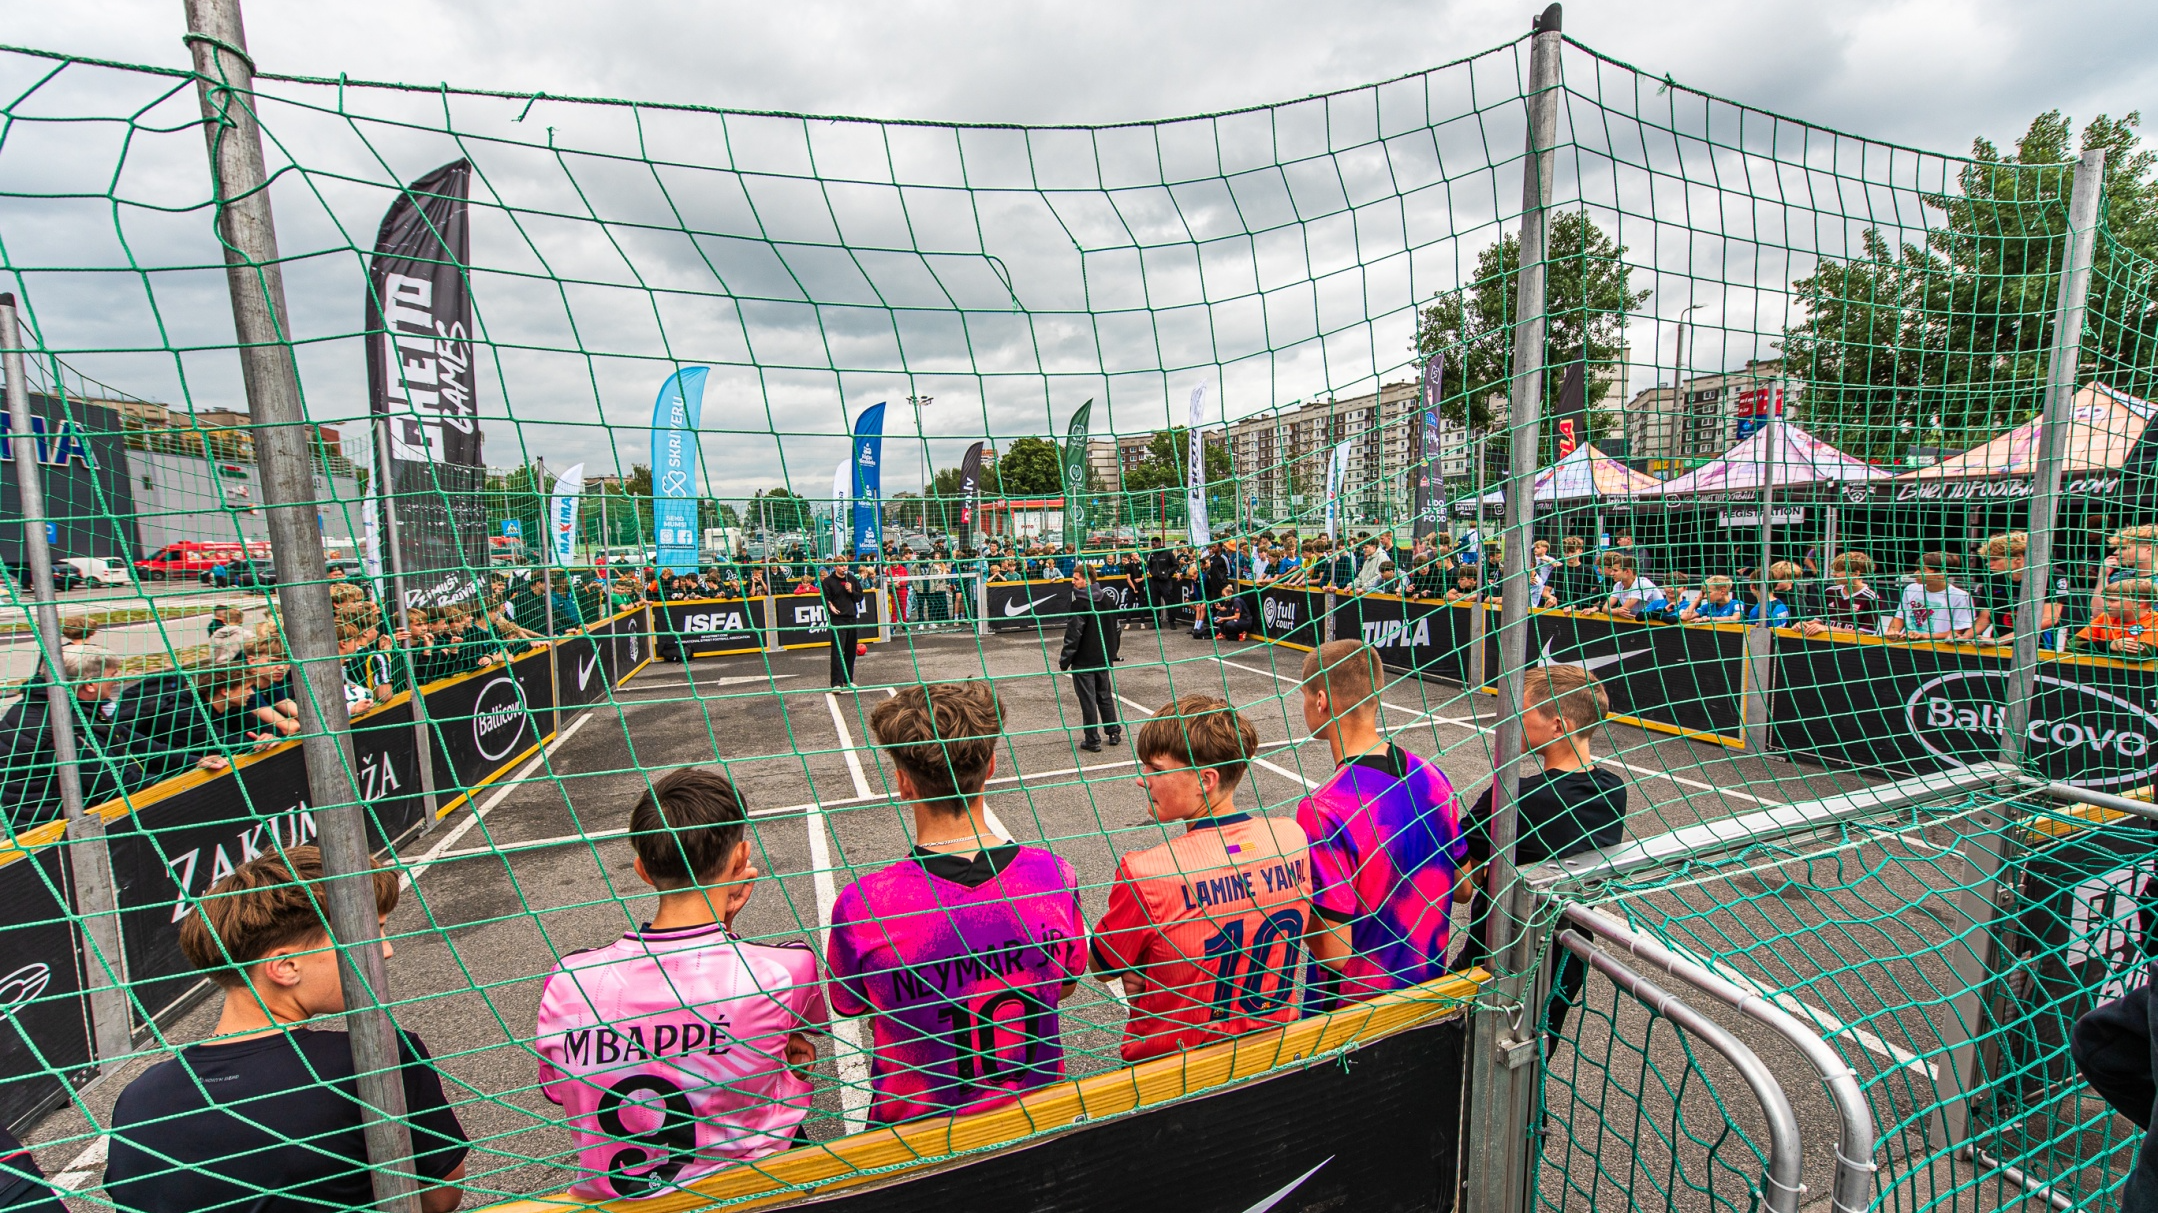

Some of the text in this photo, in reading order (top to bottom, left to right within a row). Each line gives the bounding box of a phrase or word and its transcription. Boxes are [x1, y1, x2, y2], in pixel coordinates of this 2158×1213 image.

[384, 272, 446, 462] GHETTO
[435, 320, 474, 435] GAMES
[668, 396, 685, 467] SKRĪVERU
[559, 497, 573, 555] MAXIMA
[1722, 507, 1801, 518] REGISTTION
[684, 612, 744, 633] ISFA
[1276, 619, 1294, 630] court
[1277, 601, 1296, 620] full
[1362, 617, 1430, 648] TUPLA
[1927, 697, 2149, 757] Baltcovo
[1181, 872, 1256, 910] LAMINE
[892, 939, 1024, 1002] NEYMAR
[1204, 909, 1304, 1022] 10
[563, 1014, 734, 1066] MBAPPÉ
[938, 988, 1040, 1096] 10
[597, 1074, 697, 1198] 9
